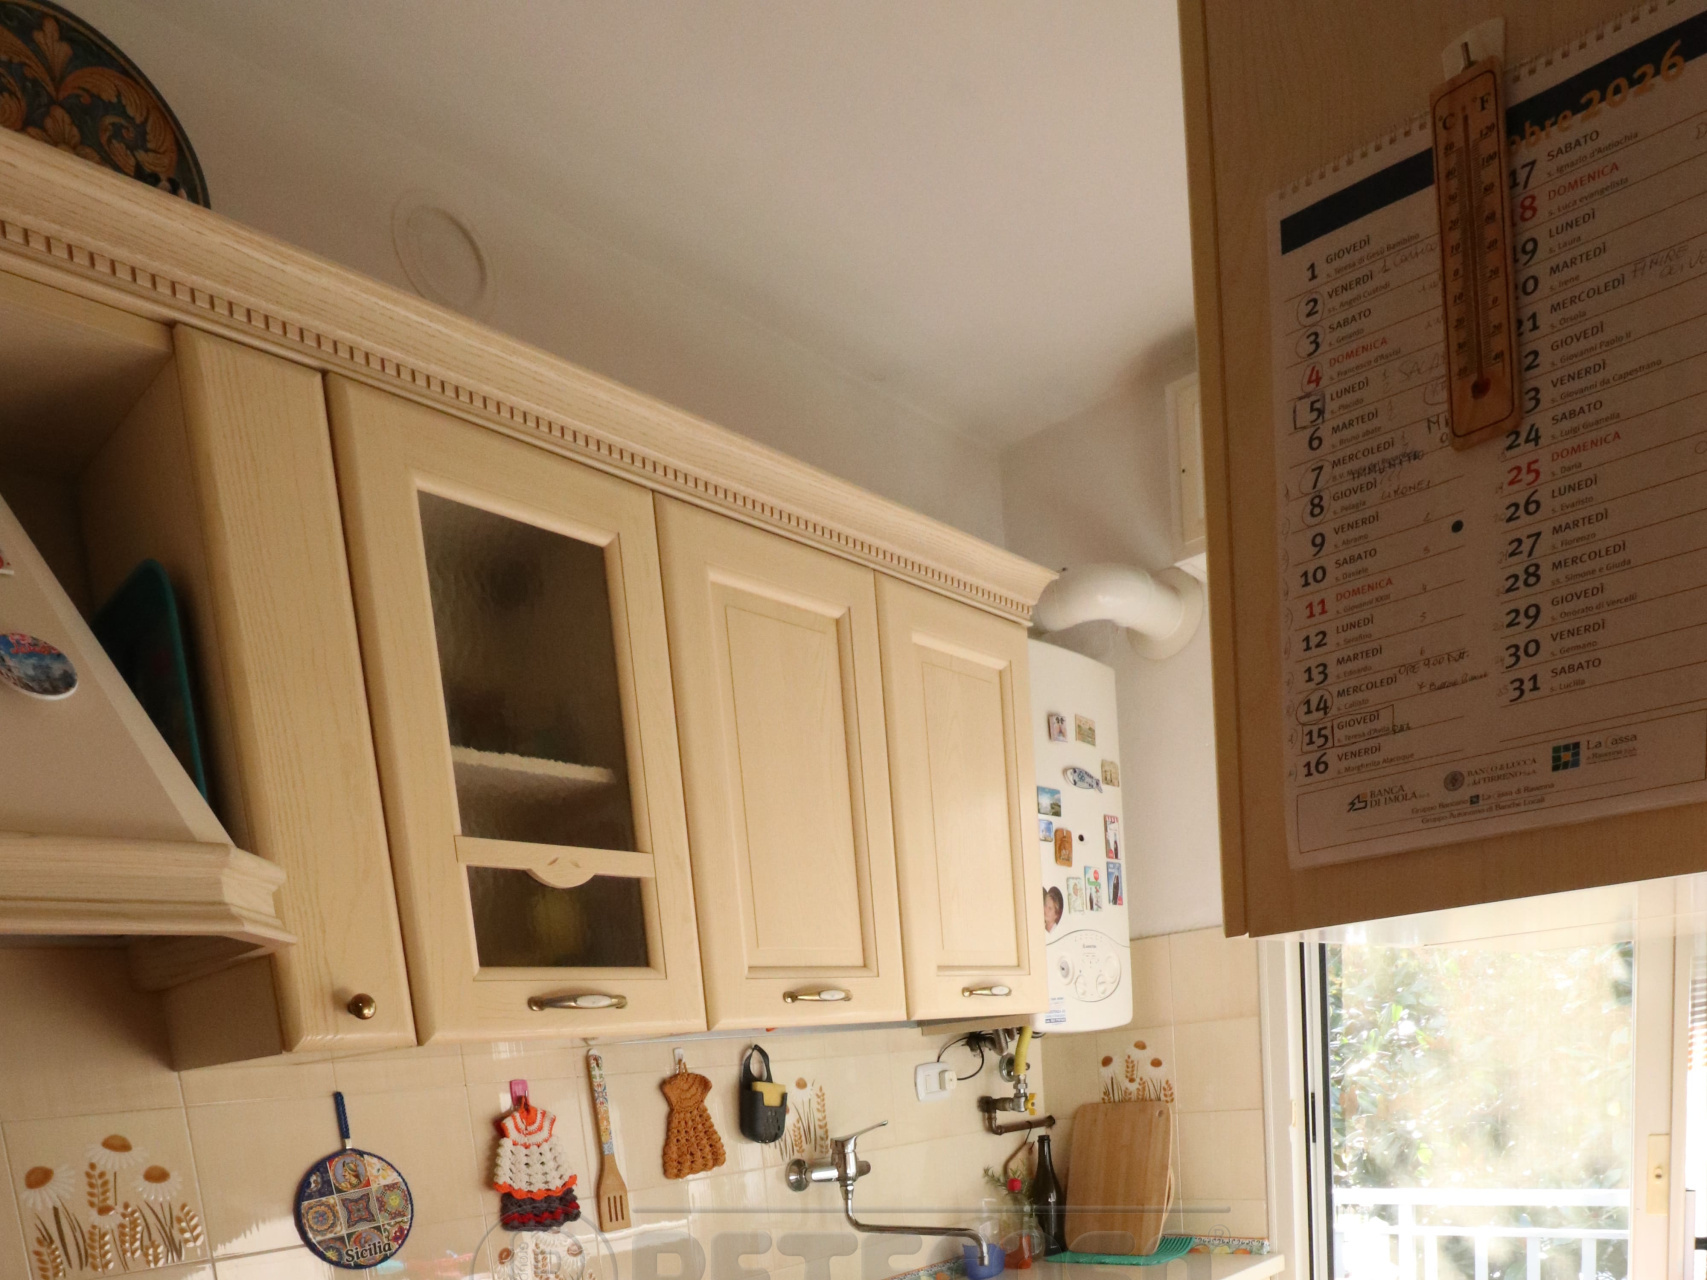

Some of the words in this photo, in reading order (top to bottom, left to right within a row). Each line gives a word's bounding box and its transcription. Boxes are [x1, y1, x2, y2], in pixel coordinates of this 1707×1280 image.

[1580, 39, 1685, 122] 2026
[1547, 130, 1600, 162] SABATO
[1481, 151, 1497, 167] 100
[1556, 155, 1587, 176] Ignazio
[1509, 160, 1537, 190] 17
[1548, 162, 1619, 201] DOMENICA
[1557, 200, 1577, 214] Luca
[1549, 208, 1596, 238] LUNEDÌ
[1326, 234, 1370, 264] GIOVEDÌ
[1558, 235, 1581, 249] Laura
[1306, 262, 1318, 281] 1
[1549, 242, 1607, 276] MARTEDÌ
[1327, 270, 1373, 299] VENERDÌ
[1550, 274, 1626, 314] MERCOLEDÌ
[1304, 297, 1319, 318] 2
[1328, 307, 1372, 332] SABATO
[1306, 331, 1321, 357] 3
[1551, 321, 1604, 352] GIOVEDÌ
[1329, 336, 1388, 367] DOMENICA
[1560, 345, 1597, 364] Giovanni
[1599, 336, 1623, 349] Paolo
[1306, 365, 1322, 388] 4
[1551, 359, 1607, 389] VENERDÌ
[1560, 383, 1597, 400] Giovanni
[1599, 378, 1611, 387] da
[1612, 359, 1662, 381] Capestrano
[1330, 376, 1369, 400] LUNEDÌ
[1309, 398, 1323, 424] 5
[1331, 408, 1379, 435] MARTEDÌ
[1551, 400, 1603, 426] SABATO
[1308, 426, 1323, 451] 6
[1505, 423, 1541, 451] 24
[1560, 424, 1580, 437] Luigi
[1332, 437, 1395, 469] MERCOLEDÌ
[1551, 431, 1621, 462] DOMENICA
[1311, 465, 1324, 490] 7
[1507, 459, 1541, 486] 25
[1332, 480, 1378, 501] GIOVEDÌ
[1551, 474, 1598, 499] LUNEDÌ
[1309, 495, 1324, 518] 8
[1505, 489, 1541, 523] 26
[1333, 512, 1379, 535] VENERDÌ
[1552, 508, 1608, 536] MARTEDÌ
[1311, 532, 1325, 557] 9
[1508, 531, 1542, 558] 27
[1552, 540, 1626, 572] MERCOLEDÌ
[1334, 548, 1377, 569] SABATO
[1565, 568, 1597, 583] Simone
[1606, 558, 1632, 571] Giuda
[1300, 566, 1327, 588] 10
[1335, 577, 1393, 602] DOMENICA
[1505, 563, 1541, 594] 28
[1551, 583, 1604, 607] GIOVEDÌ
[1305, 598, 1327, 619] 11
[1505, 603, 1542, 630] 29
[1560, 605, 1594, 619] Onorato
[1336, 615, 1374, 635] LUNEDÌ
[1551, 619, 1606, 643] VENERDÌ
[1302, 630, 1327, 652] 12
[1336, 646, 1383, 666] MARTEDÌ
[1504, 638, 1541, 670] 30
[1304, 663, 1328, 685] 13
[1551, 657, 1602, 679] SABATO
[1337, 675, 1398, 698] MERCOLEDÌ
[1509, 673, 1541, 702] 31
[1302, 694, 1329, 717] 14
[1337, 710, 1380, 730] GIOVEDÌ
[1304, 726, 1329, 748] 15
[1303, 752, 1329, 777] 16
[1337, 743, 1381, 761] VENERDÌ
[1369, 784, 1405, 799] BANCA
[1370, 797, 1382, 809] DI
[1384, 791, 1417, 807] IMOLA
[345, 1241, 392, 1262] Sicilia
